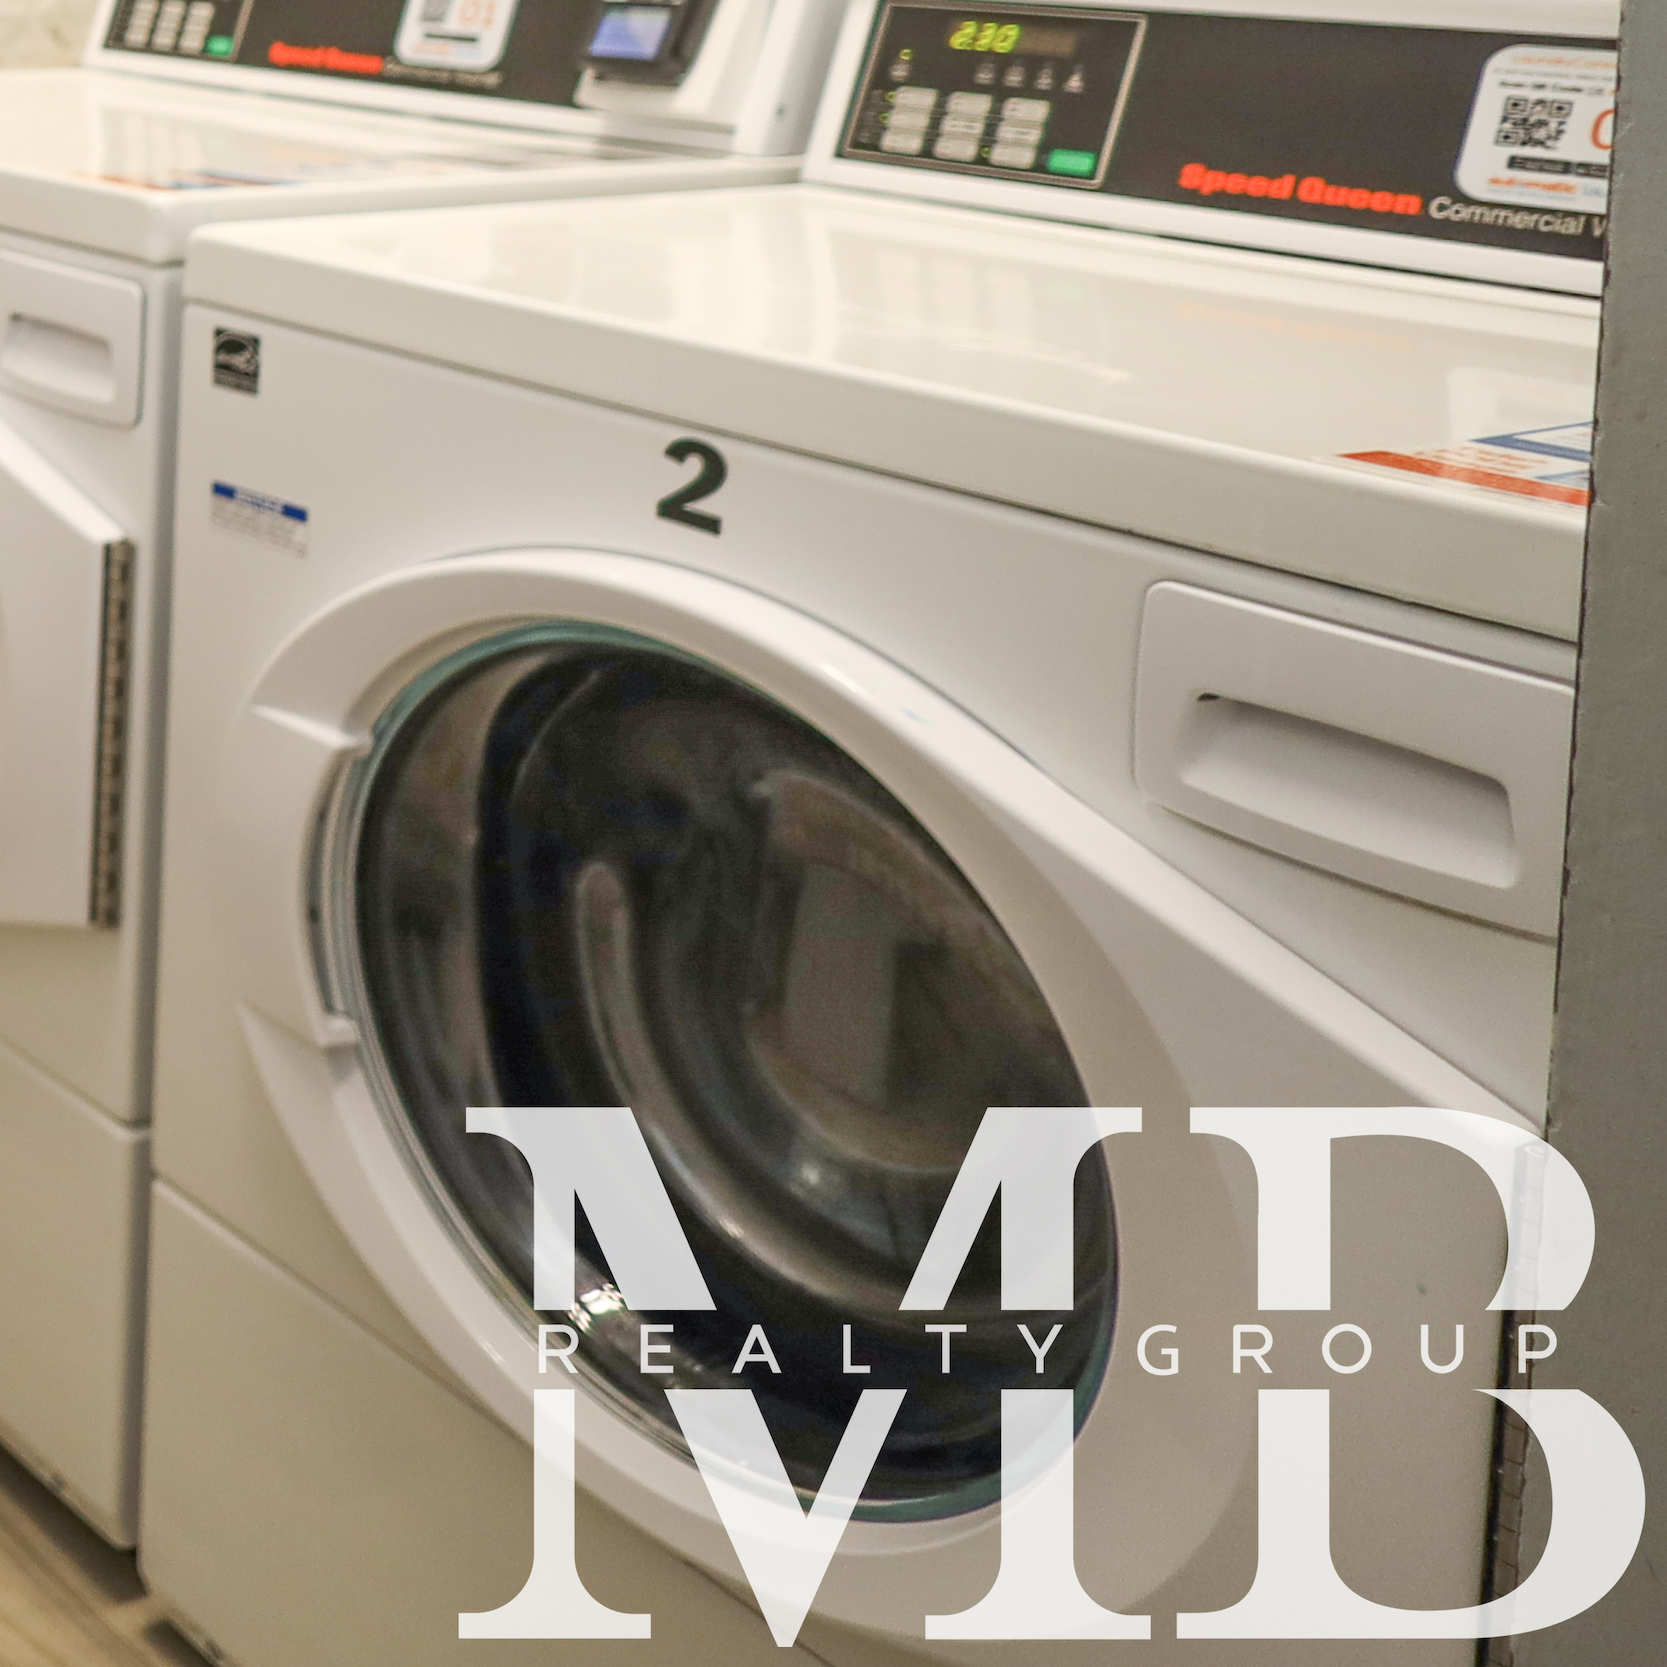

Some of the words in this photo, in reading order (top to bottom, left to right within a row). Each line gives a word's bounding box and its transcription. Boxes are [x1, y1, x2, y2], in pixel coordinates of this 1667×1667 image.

[1178, 162, 1296, 200] Speed
[1297, 176, 1423, 215] Queen
[1427, 196, 1583, 236] Commercial
[657, 437, 727, 537] 2
